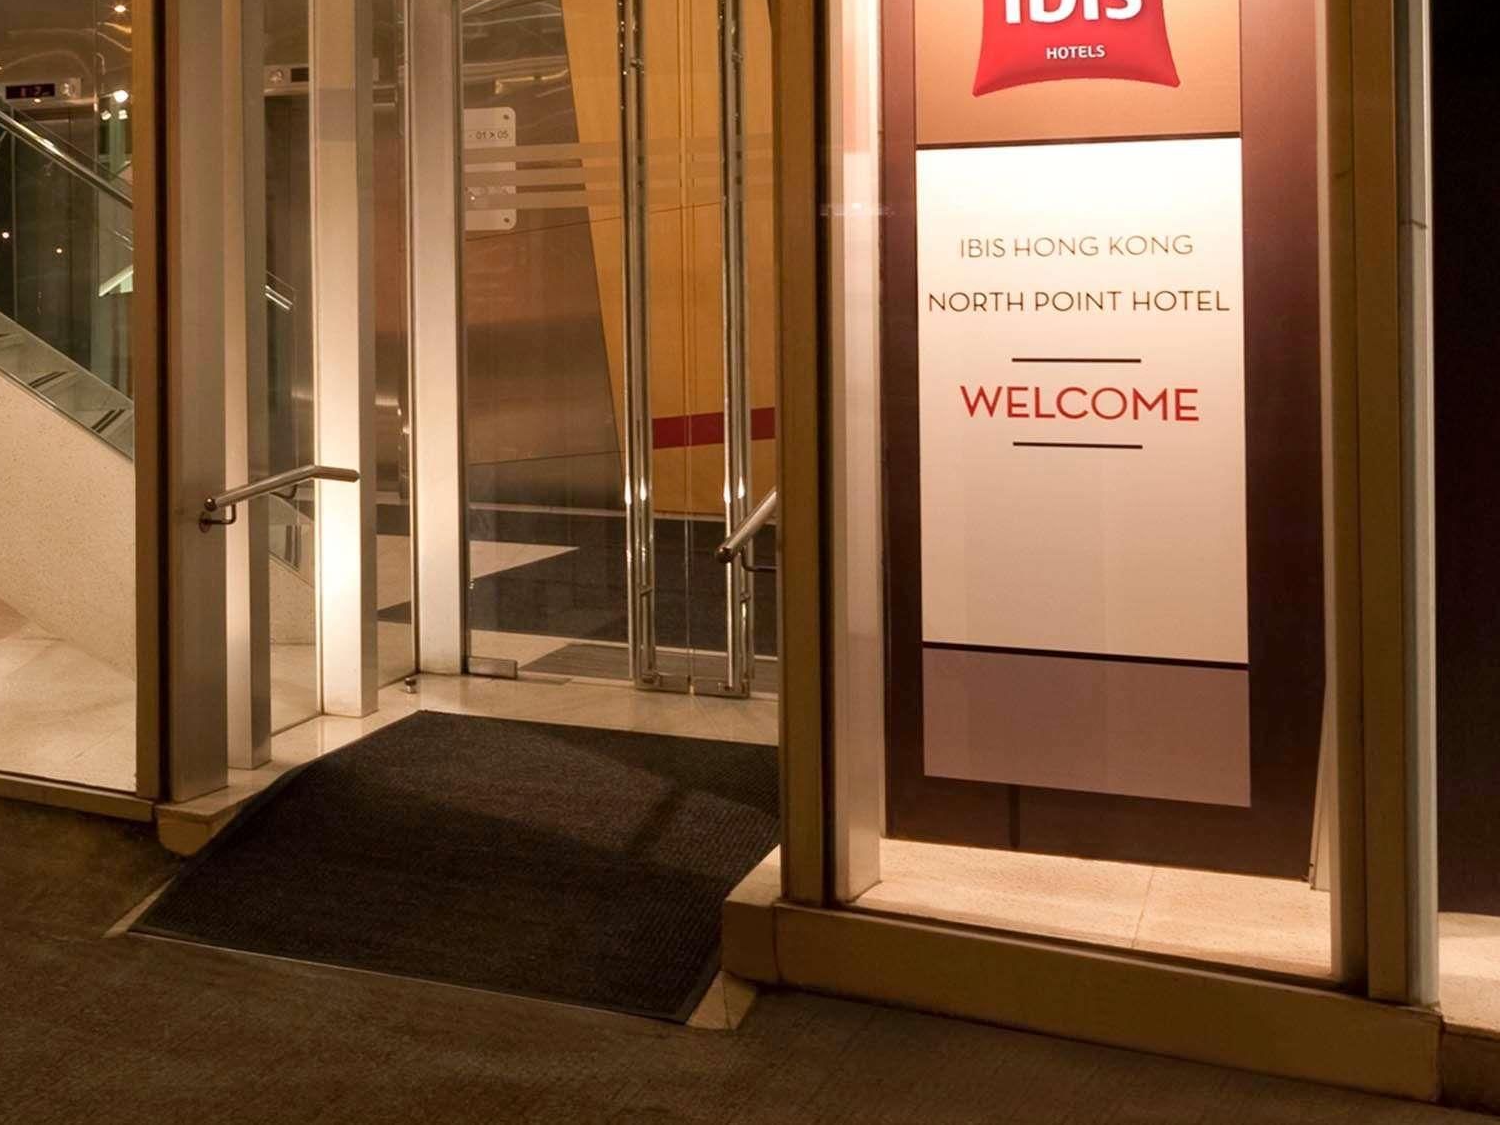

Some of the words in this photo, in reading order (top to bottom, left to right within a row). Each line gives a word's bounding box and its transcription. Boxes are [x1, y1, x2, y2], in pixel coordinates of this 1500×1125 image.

[1045, 43, 1106, 60] HOTELS
[959, 238, 1007, 259] IBIS
[1013, 236, 1100, 258] HONG
[1107, 233, 1195, 257] KONG
[928, 290, 1025, 313] NORTH
[1034, 290, 1123, 313] POINT
[1132, 289, 1231, 313] HOTEL
[959, 384, 1200, 422] WELCOME
